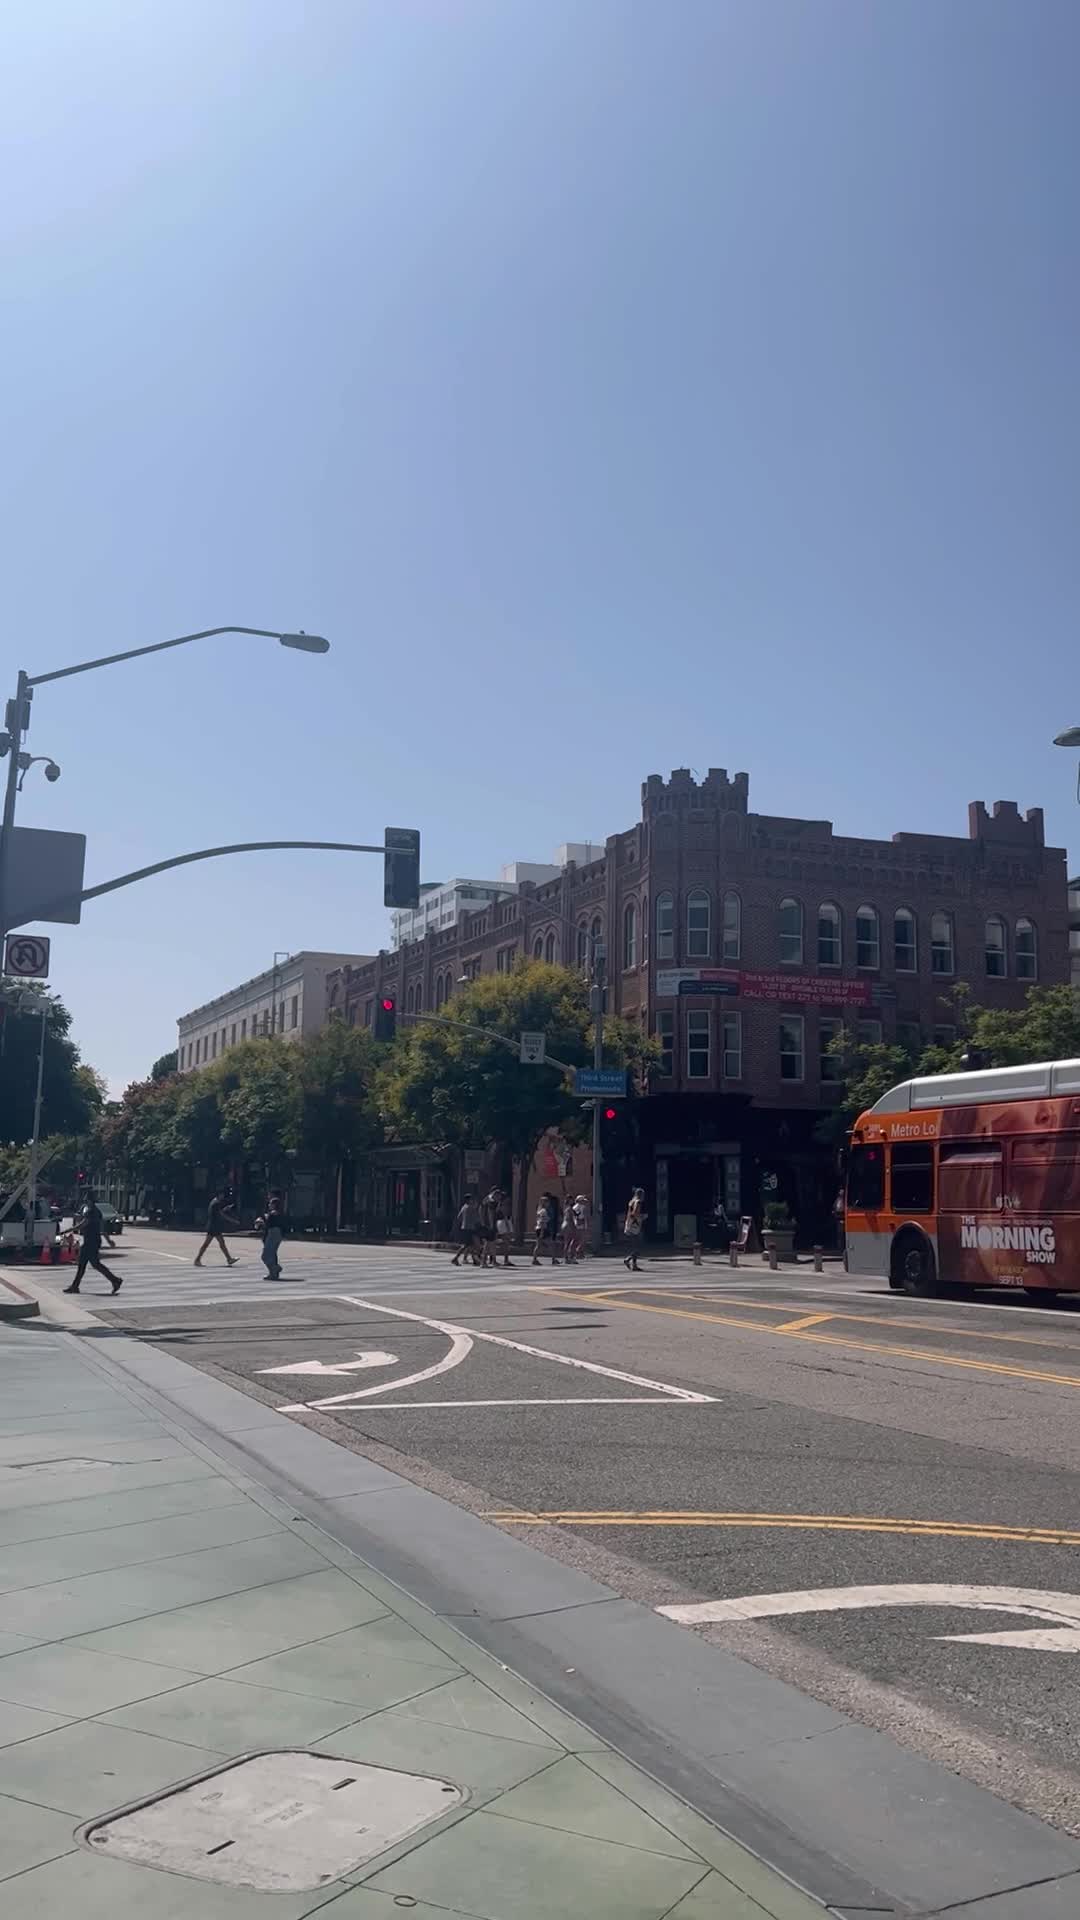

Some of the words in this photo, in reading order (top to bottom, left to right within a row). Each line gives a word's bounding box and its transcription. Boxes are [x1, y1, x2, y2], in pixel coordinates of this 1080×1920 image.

[744, 989, 763, 997] CALL
[778, 991, 796, 1000] TEXT
[580, 1073, 598, 1081] Third
[600, 1073, 623, 1082] Street
[890, 1123, 920, 1138] Metro
[960, 1215, 976, 1224] THE
[961, 1226, 1056, 1251] MORNING
[1026, 1251, 1056, 1264] SHOW
[999, 1275, 1014, 1285] SEPT
